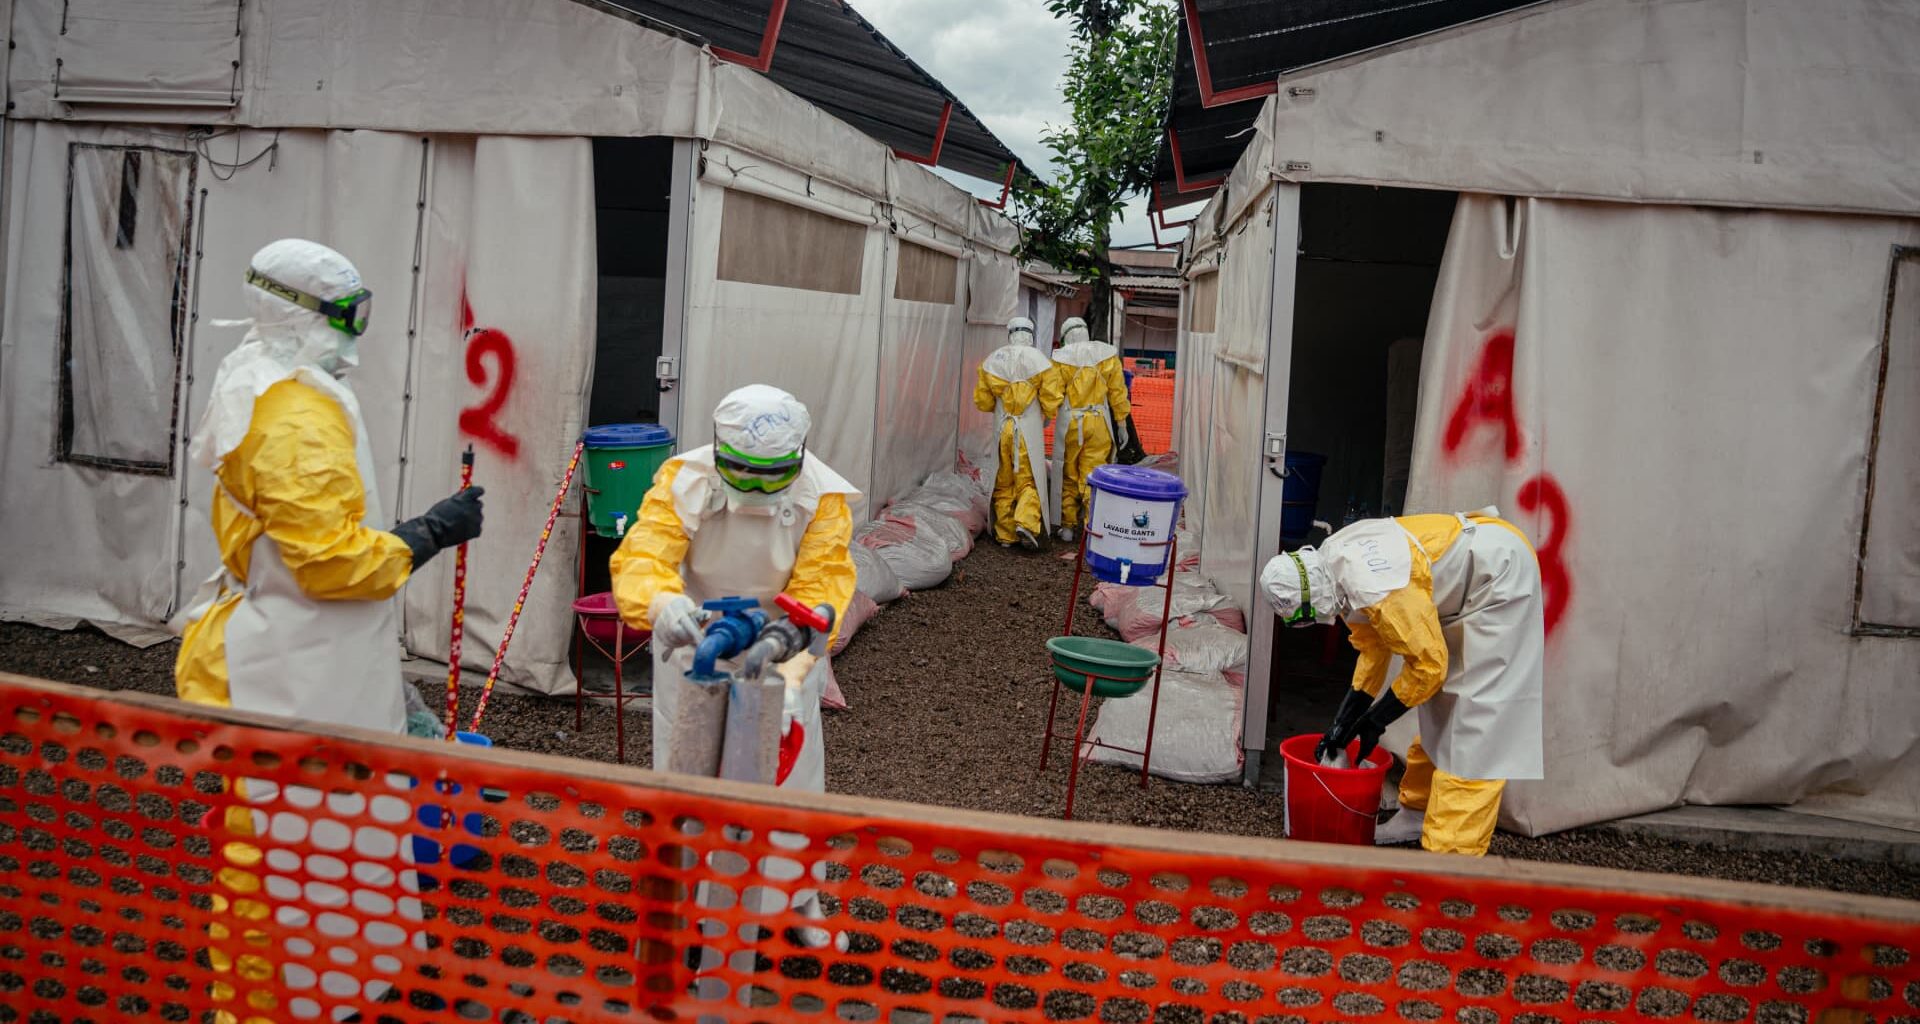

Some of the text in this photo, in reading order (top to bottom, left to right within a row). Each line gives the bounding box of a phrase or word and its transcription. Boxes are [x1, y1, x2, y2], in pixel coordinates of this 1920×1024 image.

[459, 328, 518, 460] 2
[1443, 329, 1523, 462] A
[1103, 522, 1129, 535] LAVAGE
[1131, 529, 1155, 537] GANTS
[1517, 473, 1573, 640] 3
